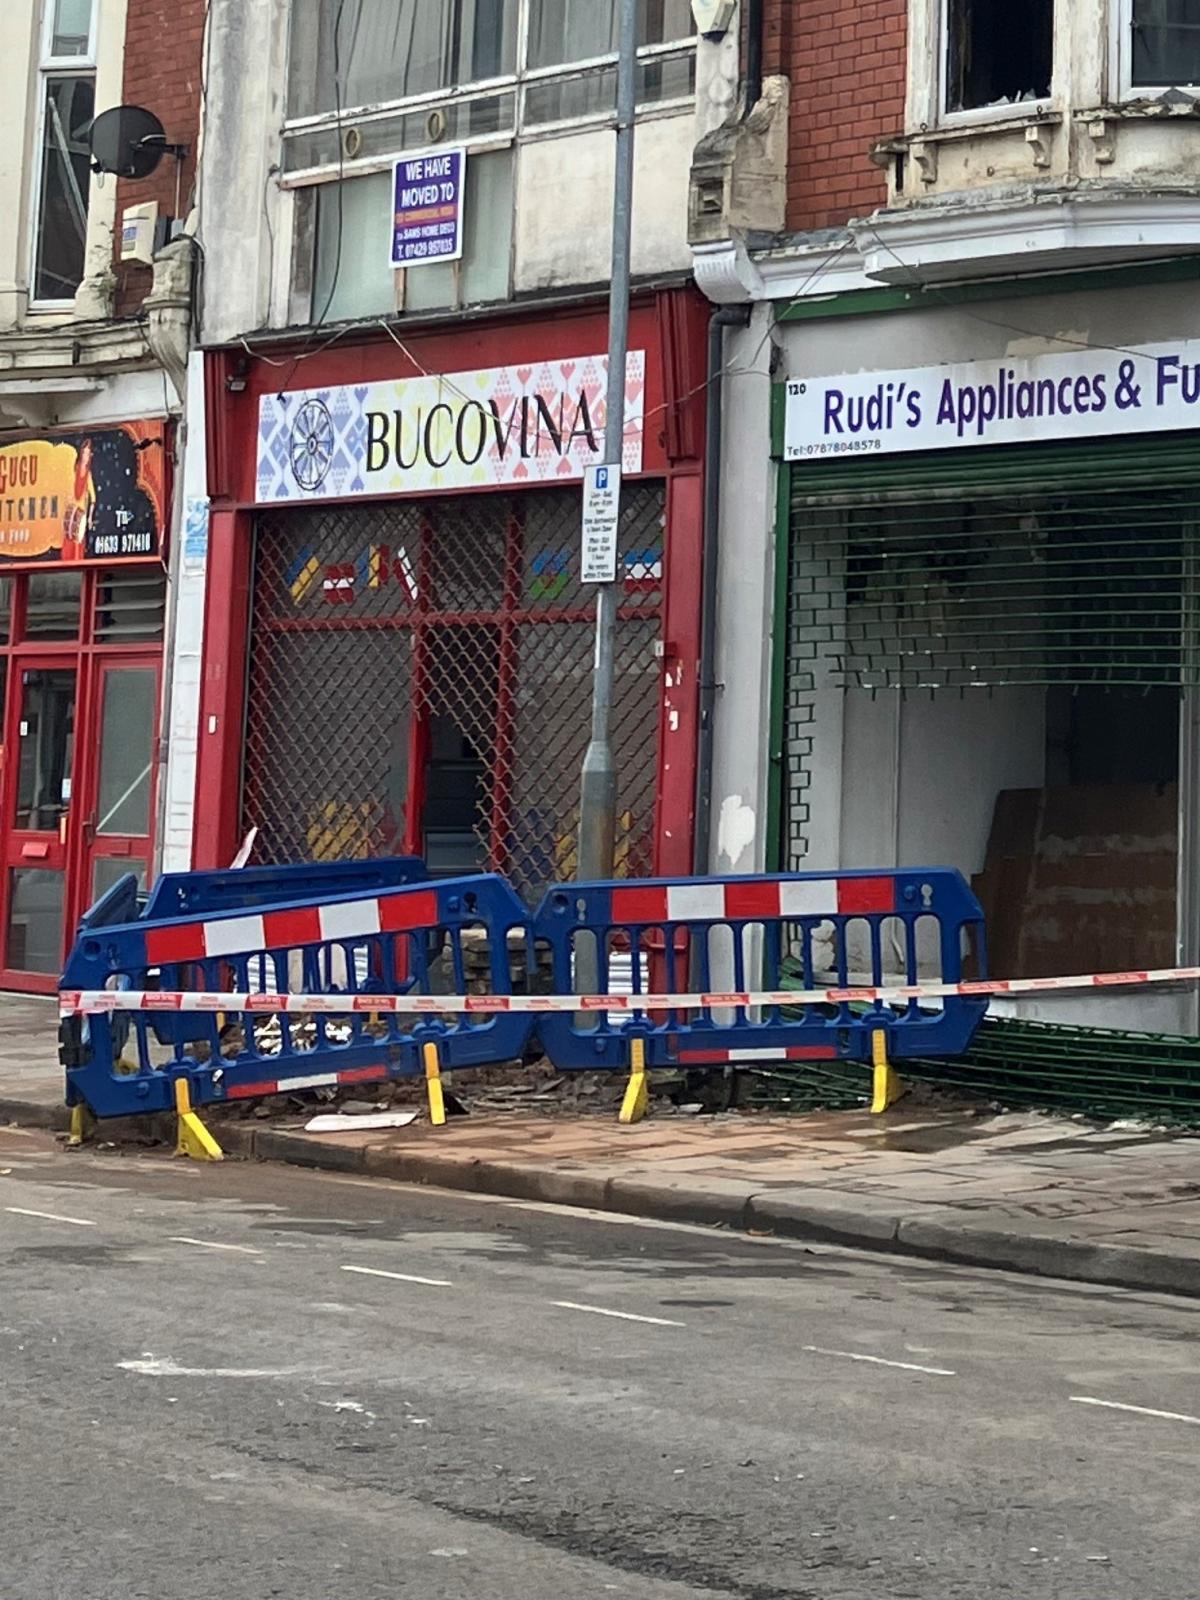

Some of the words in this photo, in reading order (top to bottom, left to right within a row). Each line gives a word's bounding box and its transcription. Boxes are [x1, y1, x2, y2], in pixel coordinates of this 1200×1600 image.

[406, 163, 423, 181] WE
[424, 157, 451, 179] HAVE
[401, 184, 439, 208] MOVED
[440, 182, 454, 202] TO
[788, 383, 806, 396] 120
[824, 381, 922, 435] Rudi's
[936, 368, 1107, 437] Appliances
[1114, 359, 1142, 410] &
[365, 388, 600, 473] BUCOVINA
